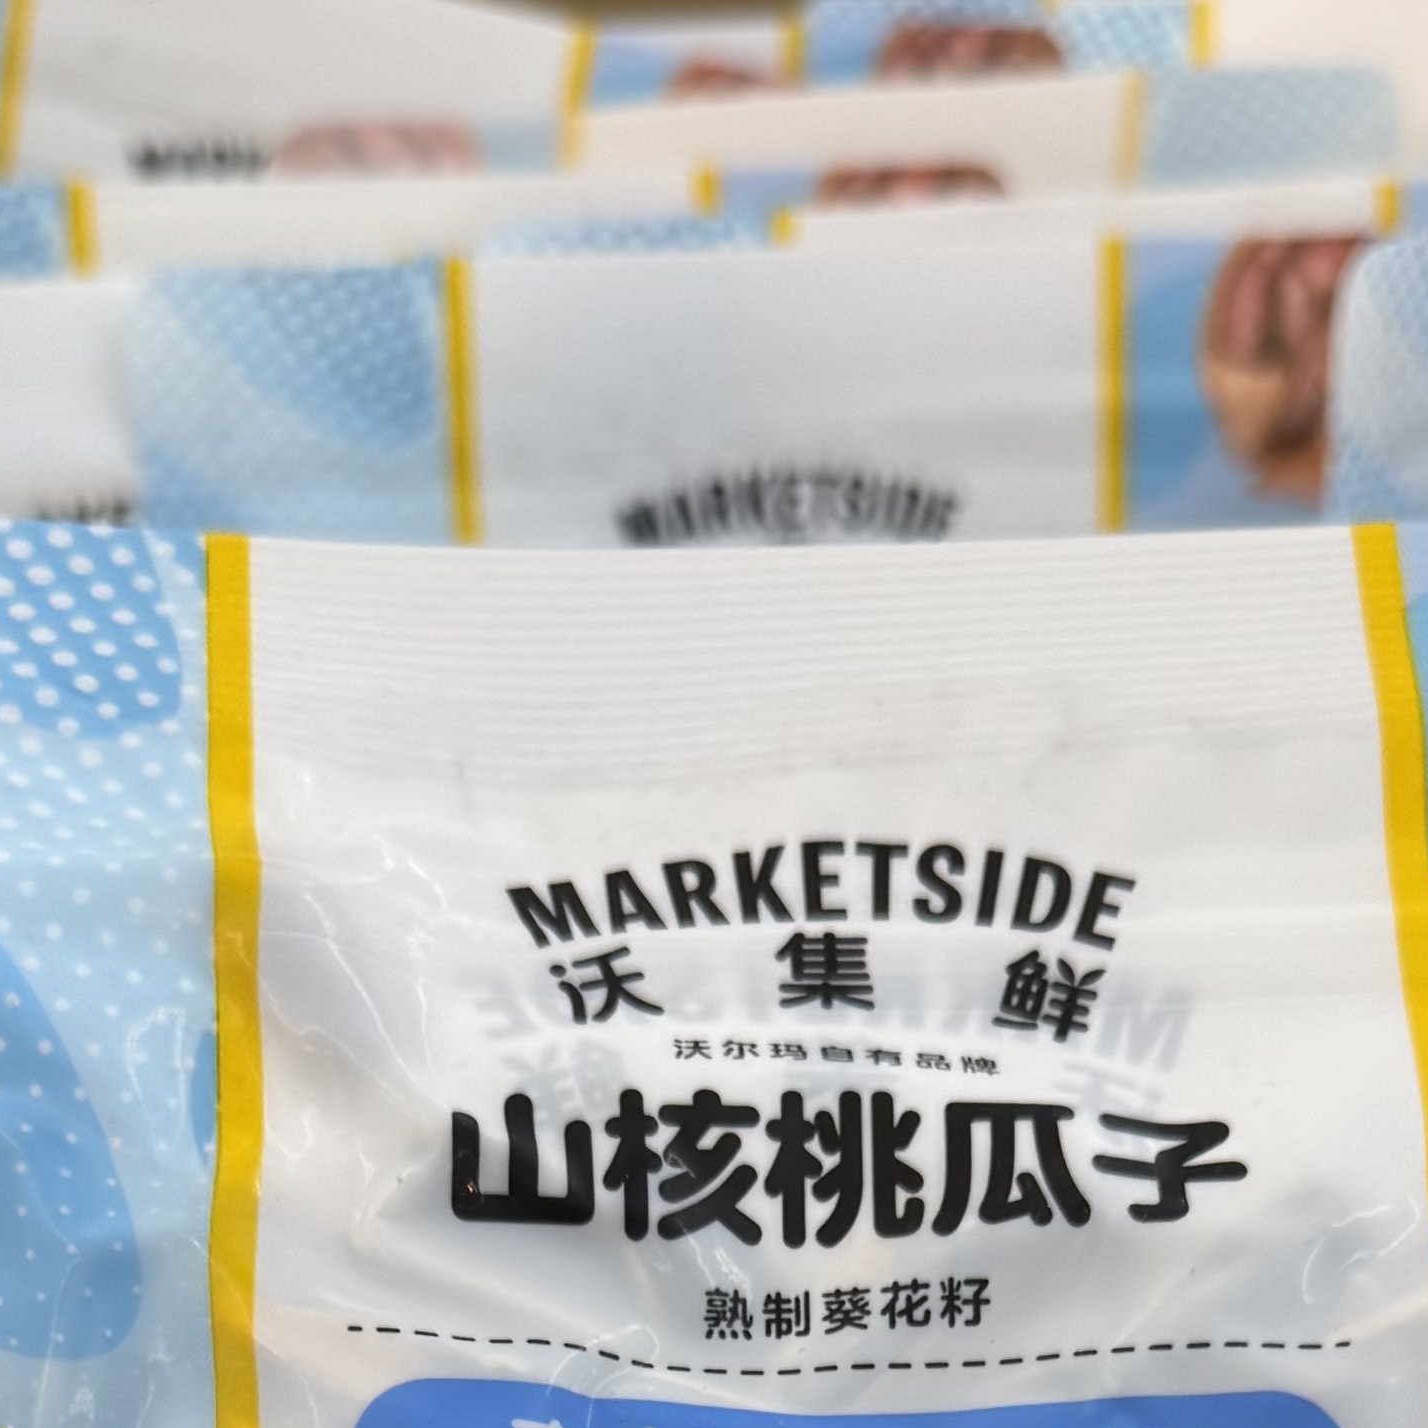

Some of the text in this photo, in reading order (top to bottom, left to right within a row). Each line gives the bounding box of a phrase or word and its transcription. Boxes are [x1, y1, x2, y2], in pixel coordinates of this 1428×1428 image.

[507, 838, 1137, 952] MARKETSIDE
[546, 930, 1108, 1043] 沃集鲜
[672, 1037, 1002, 1077] 沃尔玛自有品牌
[450, 1086, 1249, 1250] 山核桃瓜子
[702, 1275, 993, 1340] 熟制葵花籽
